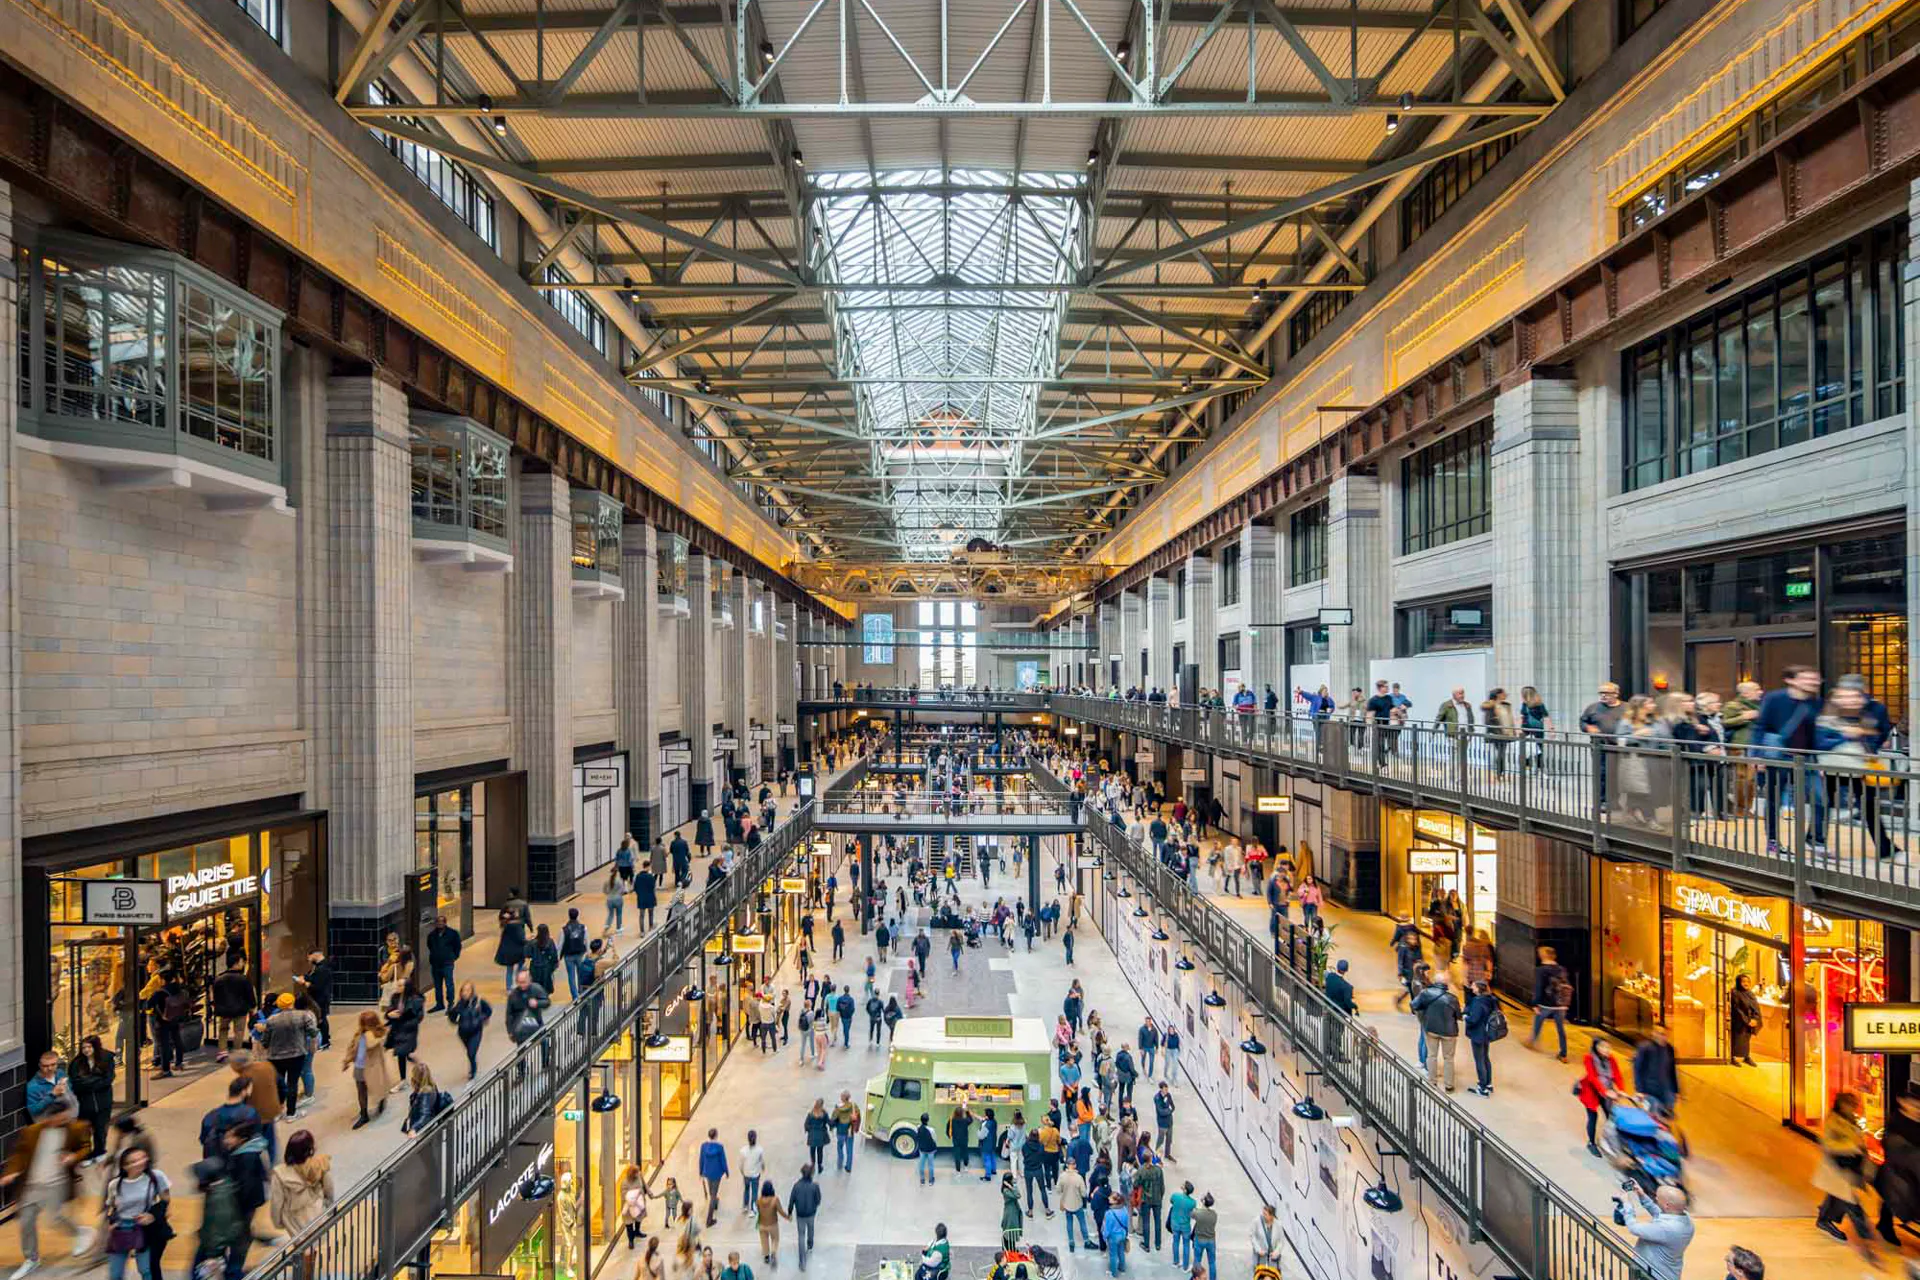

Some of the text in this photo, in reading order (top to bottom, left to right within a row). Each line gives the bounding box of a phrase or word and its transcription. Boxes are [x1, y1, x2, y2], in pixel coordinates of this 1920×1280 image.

[168, 863, 235, 894] PARIS
[167, 876, 258, 915] GUETTE
[1867, 1022, 1885, 1034] LE
